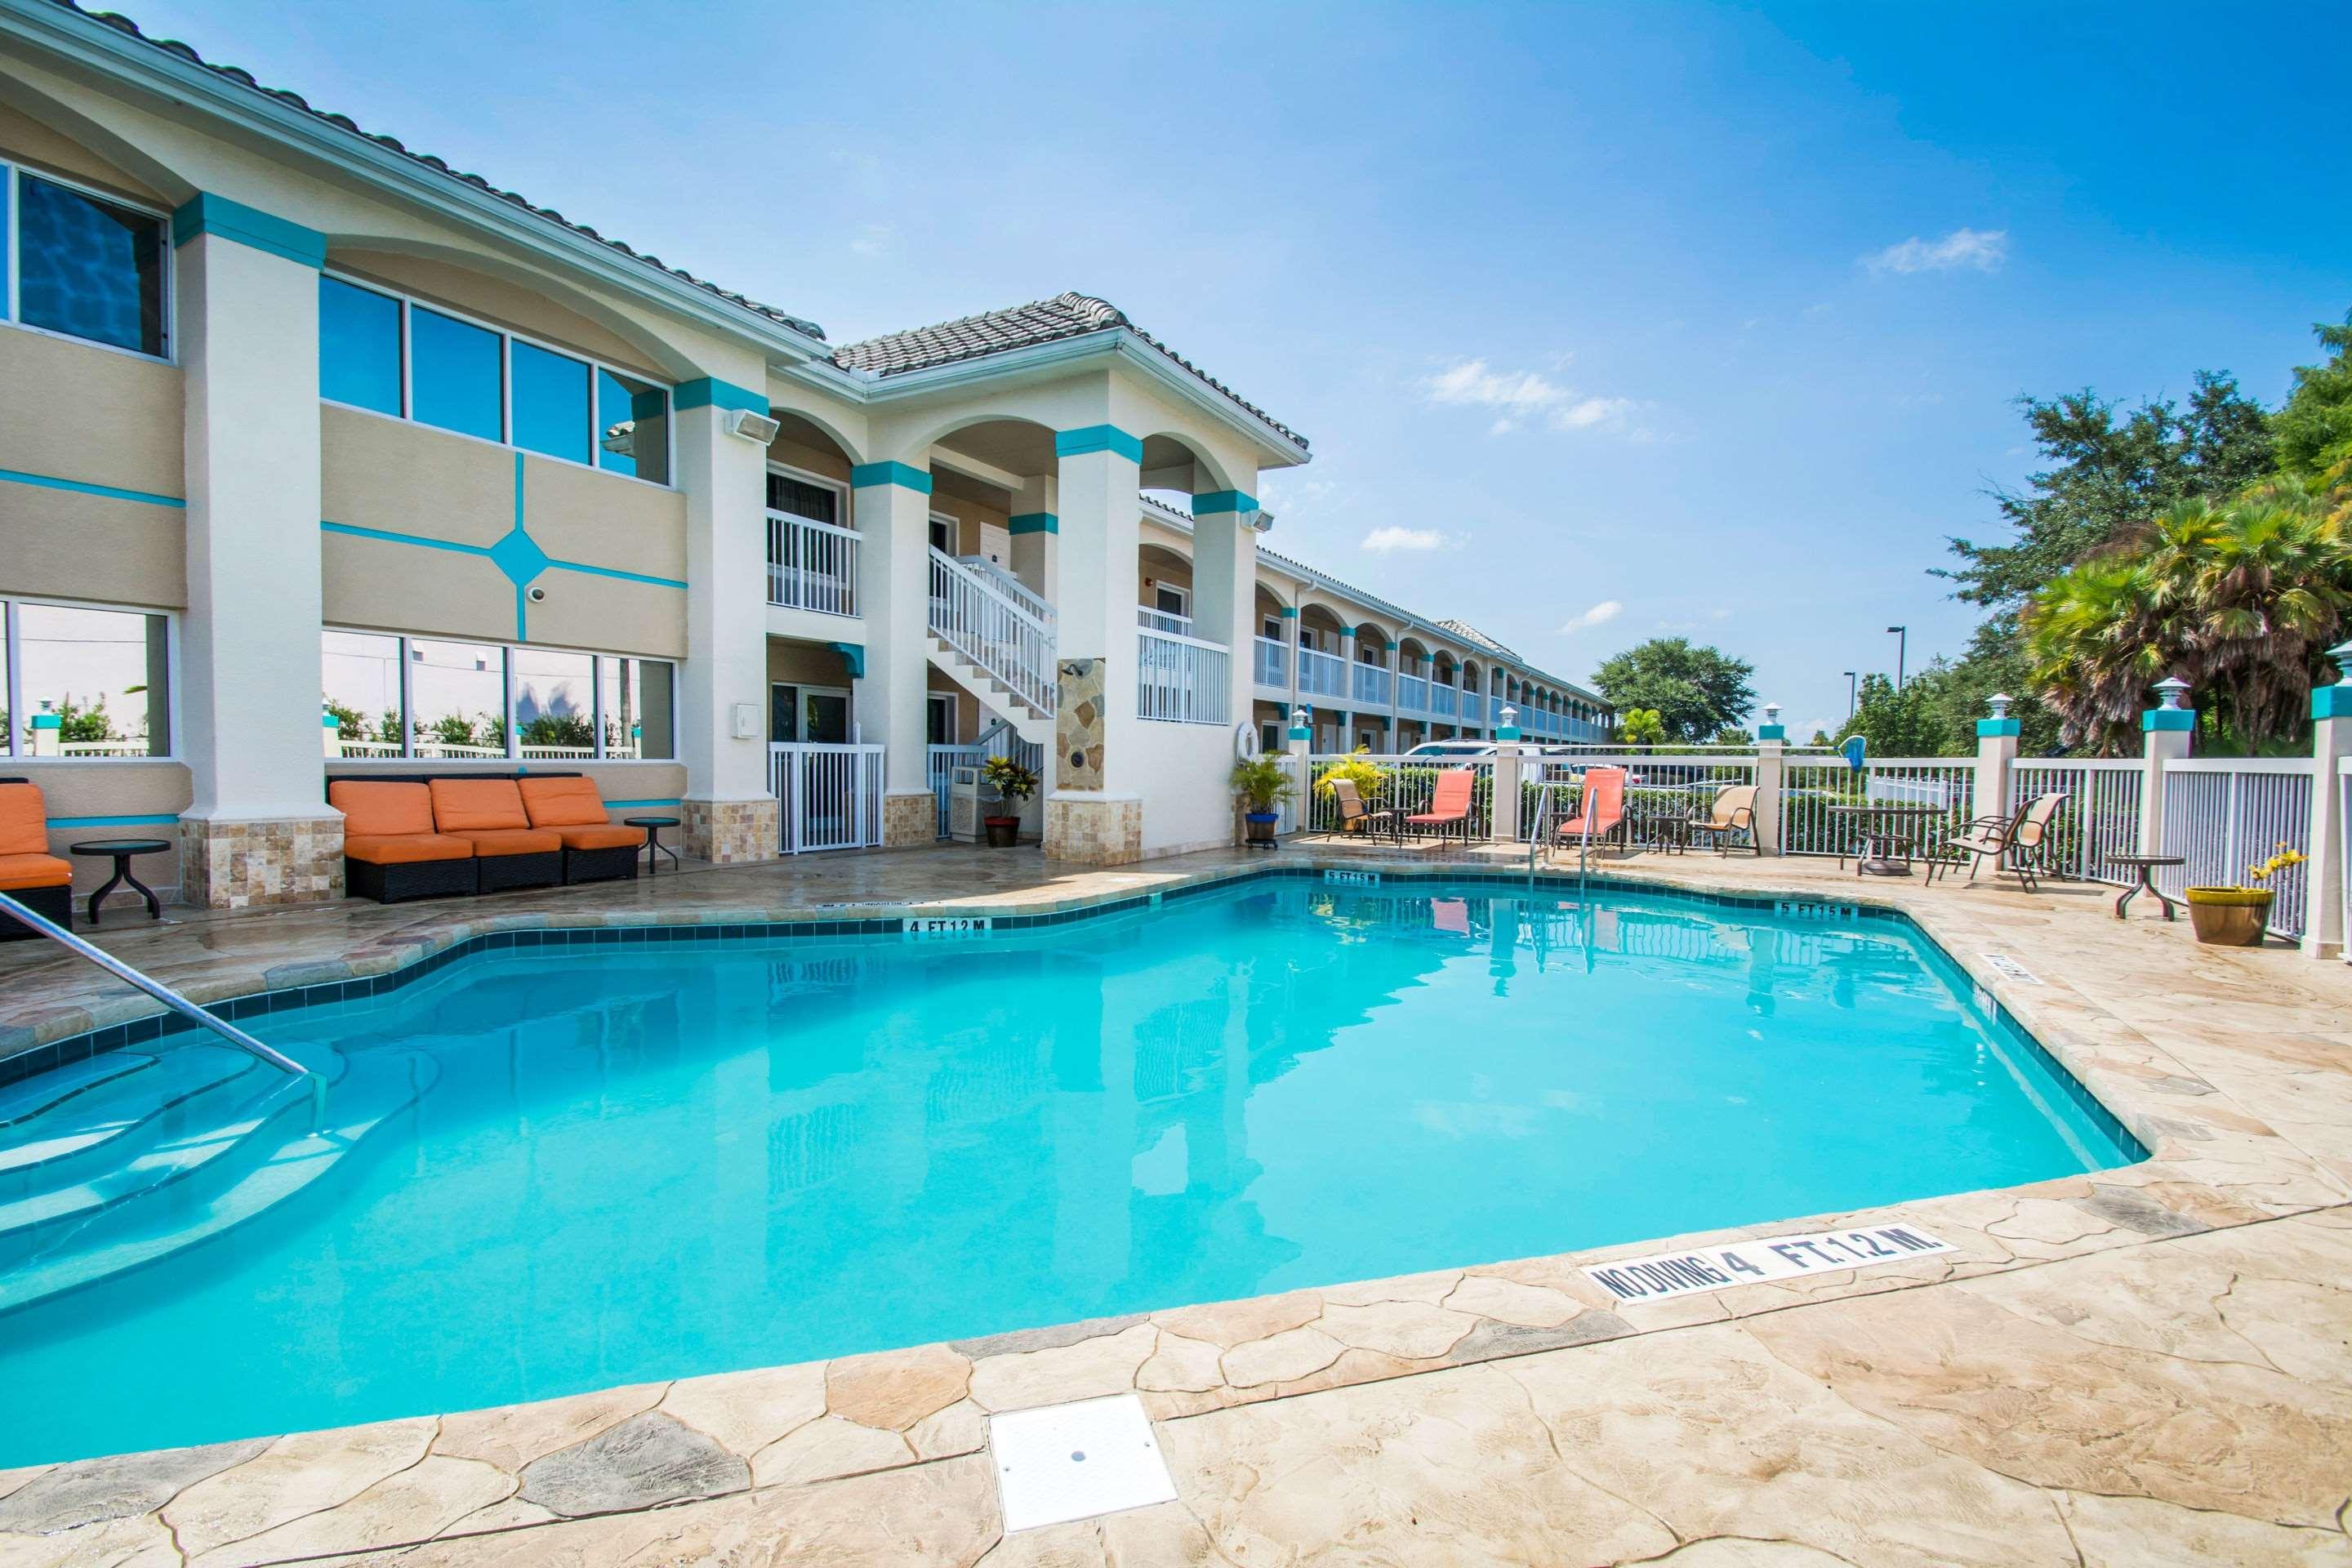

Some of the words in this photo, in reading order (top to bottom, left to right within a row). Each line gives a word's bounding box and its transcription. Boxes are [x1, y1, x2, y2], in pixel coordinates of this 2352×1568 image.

[910, 920, 920, 932] 4
[928, 920, 946, 932] FT
[973, 920, 985, 930] M
[1590, 1267, 1648, 1298] NO
[1625, 1256, 1732, 1294] DIVING
[1720, 1252, 1766, 1276] 4
